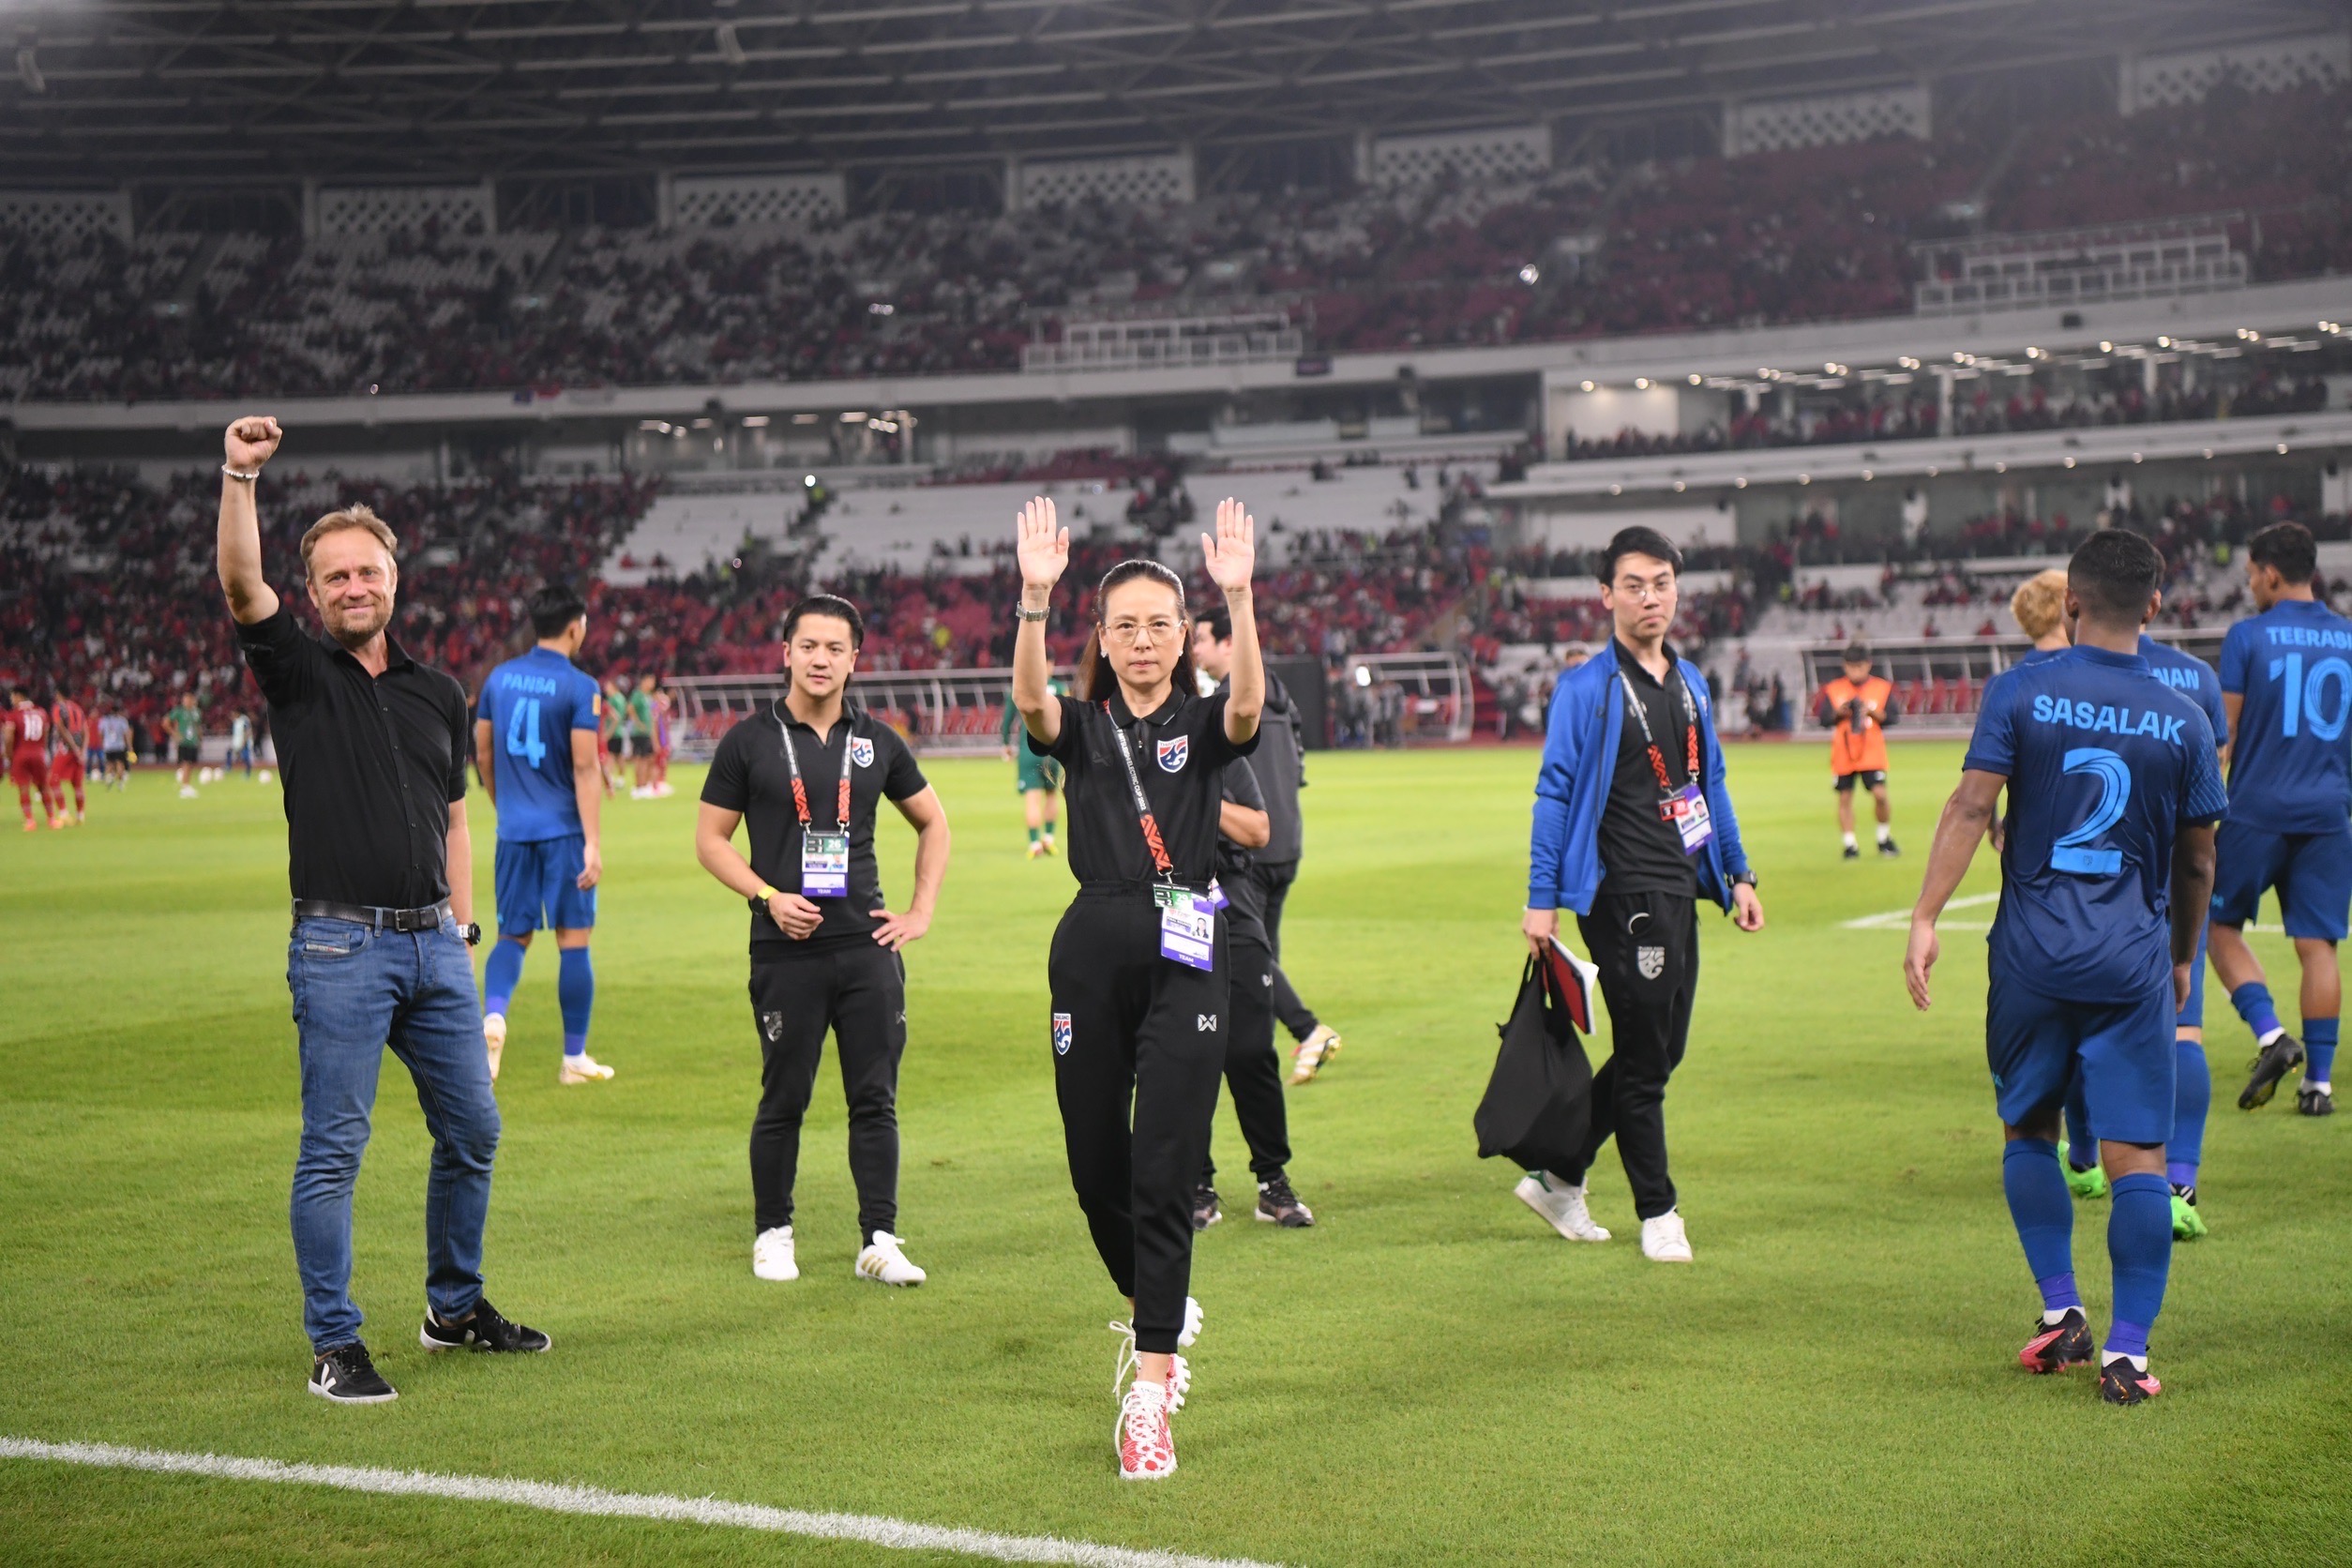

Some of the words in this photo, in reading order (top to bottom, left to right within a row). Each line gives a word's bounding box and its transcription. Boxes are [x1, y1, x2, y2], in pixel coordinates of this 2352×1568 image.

[2033, 695, 2187, 746] SASALAK
[2269, 653, 2352, 741] 10
[507, 697, 546, 769] 4
[1126, 760, 1138, 785] ELECTRIC
[1138, 796, 1146, 811] 2022
[2051, 747, 2132, 874] 2
[1179, 954, 1194, 963] TEAM
